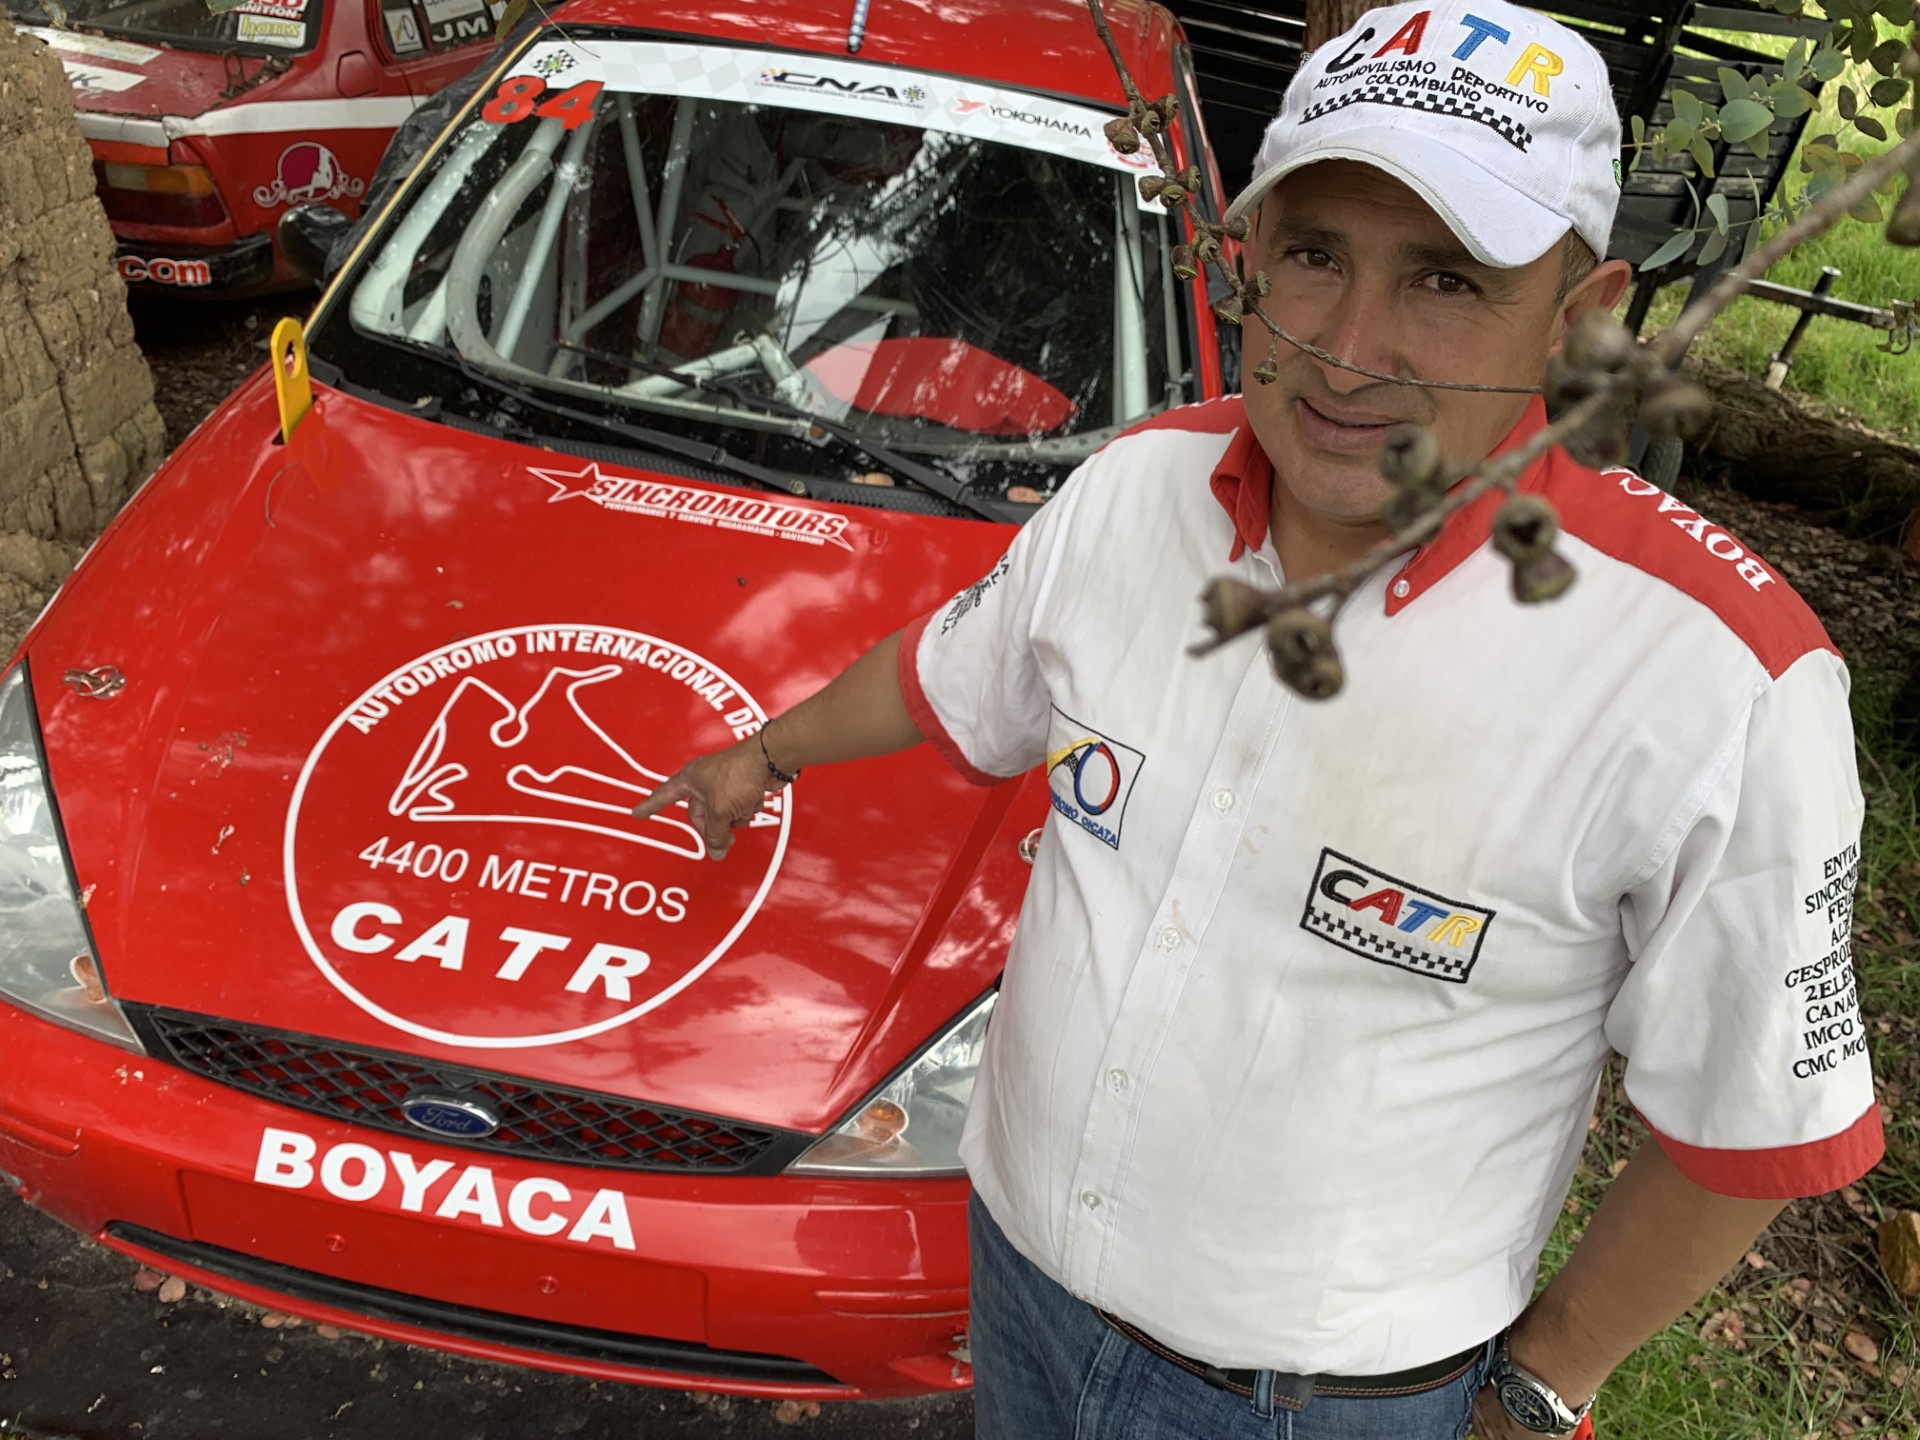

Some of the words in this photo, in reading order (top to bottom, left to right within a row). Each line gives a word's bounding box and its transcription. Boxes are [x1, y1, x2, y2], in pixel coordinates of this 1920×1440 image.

[431, 16, 489, 42] JM
[1325, 10, 1564, 97] CATR
[481, 75, 605, 131] 84
[774, 72, 899, 100] CNA
[1313, 60, 1436, 90] AUTOMOVILISMO
[1451, 67, 1549, 114] DEPORTIVO
[1365, 74, 1482, 102] COLOMBIANO
[988, 105, 1092, 139] YOKOHAMA
[594, 478, 849, 537] SINCROMOTORS
[347, 636, 518, 734] AUTODROMO
[525, 630, 736, 710] INTERNACIONAL
[724, 706, 763, 741] DE
[1081, 816, 1116, 845] OICATA
[359, 836, 469, 883] 4400
[478, 855, 690, 924] METROS
[1319, 868, 1485, 948] CATR
[330, 901, 652, 1002] CATR
[1803, 1018, 1854, 1050] IMCO
[1792, 1048, 1838, 1079] CMC
[421, 1107, 472, 1131] Ford
[253, 1126, 636, 1251] BOYACA
